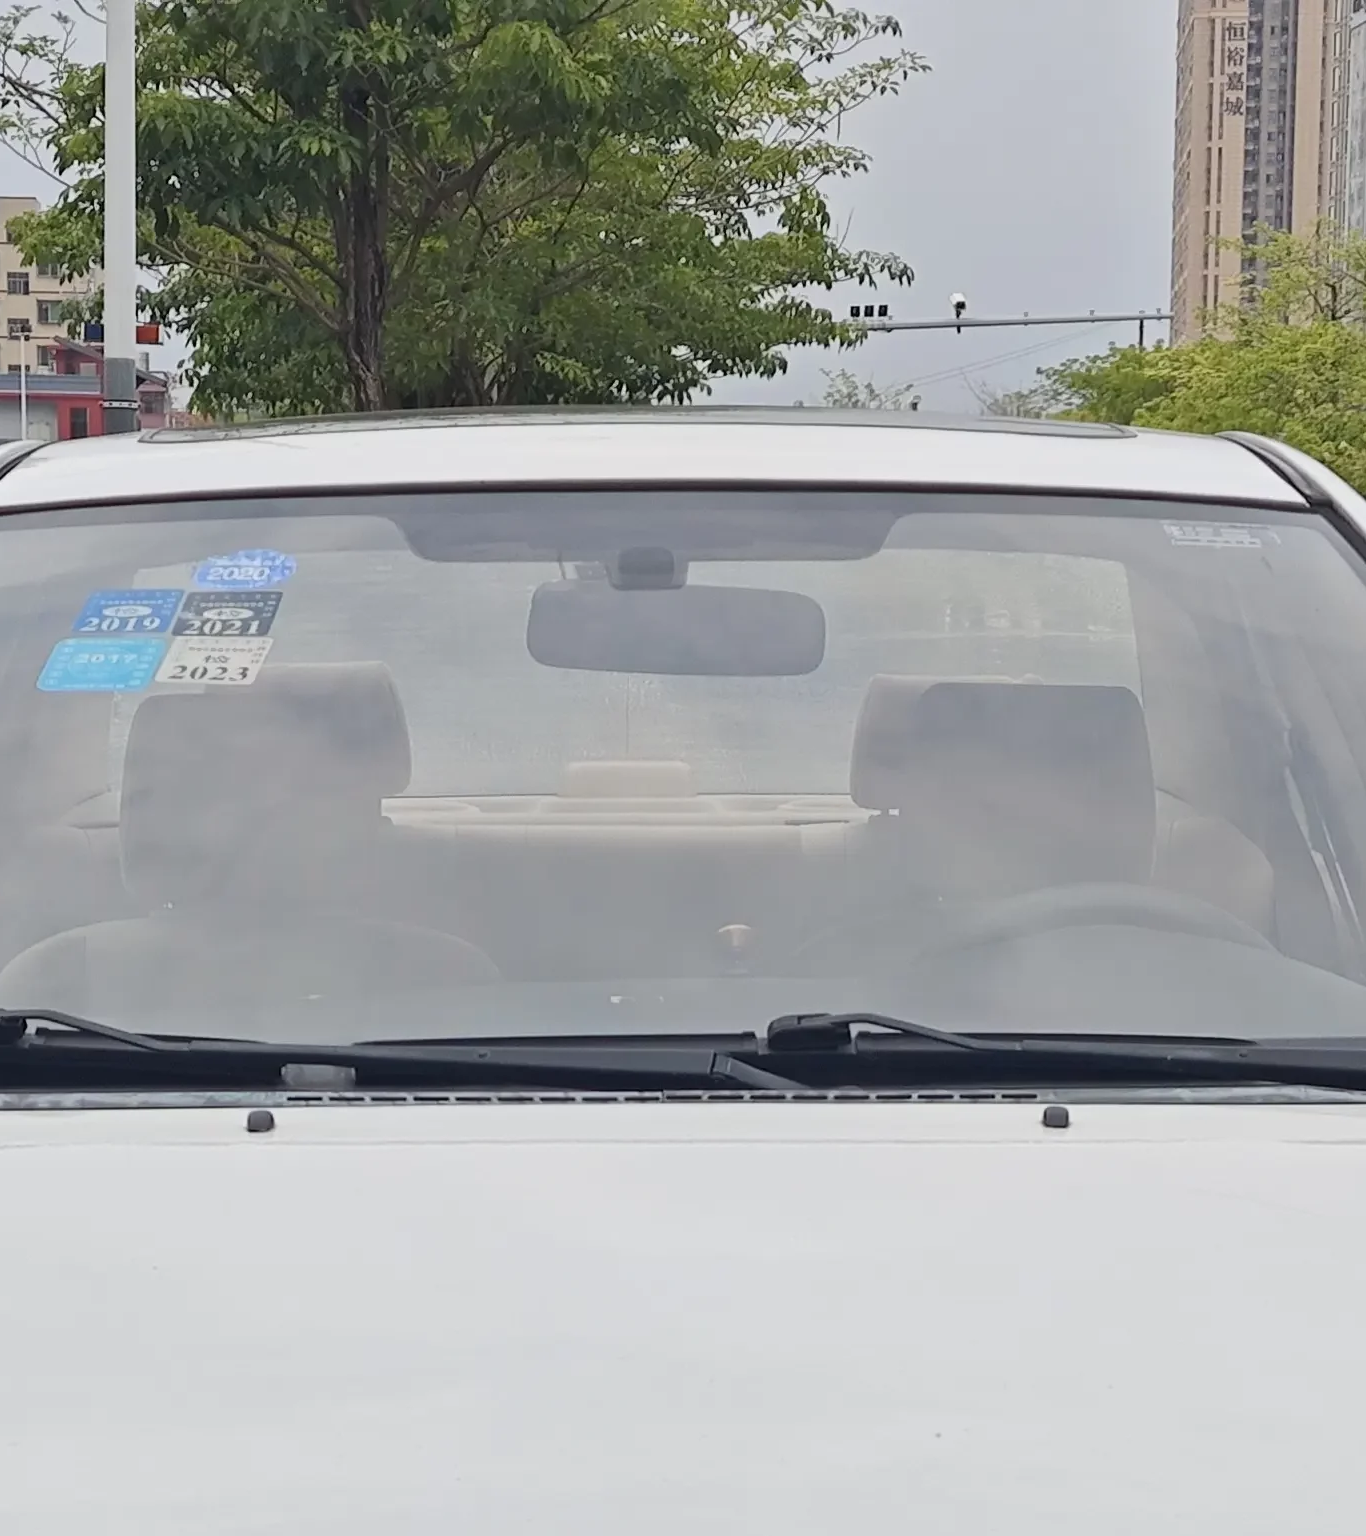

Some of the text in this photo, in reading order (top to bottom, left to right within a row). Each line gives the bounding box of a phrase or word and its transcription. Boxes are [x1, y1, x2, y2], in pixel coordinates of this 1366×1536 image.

[1223, 21, 1246, 116] 恒裕嘉城
[206, 566, 271, 581] 2020
[78, 616, 162, 632] 2019
[182, 619, 261, 636] 2021
[167, 665, 250, 682] 2023
